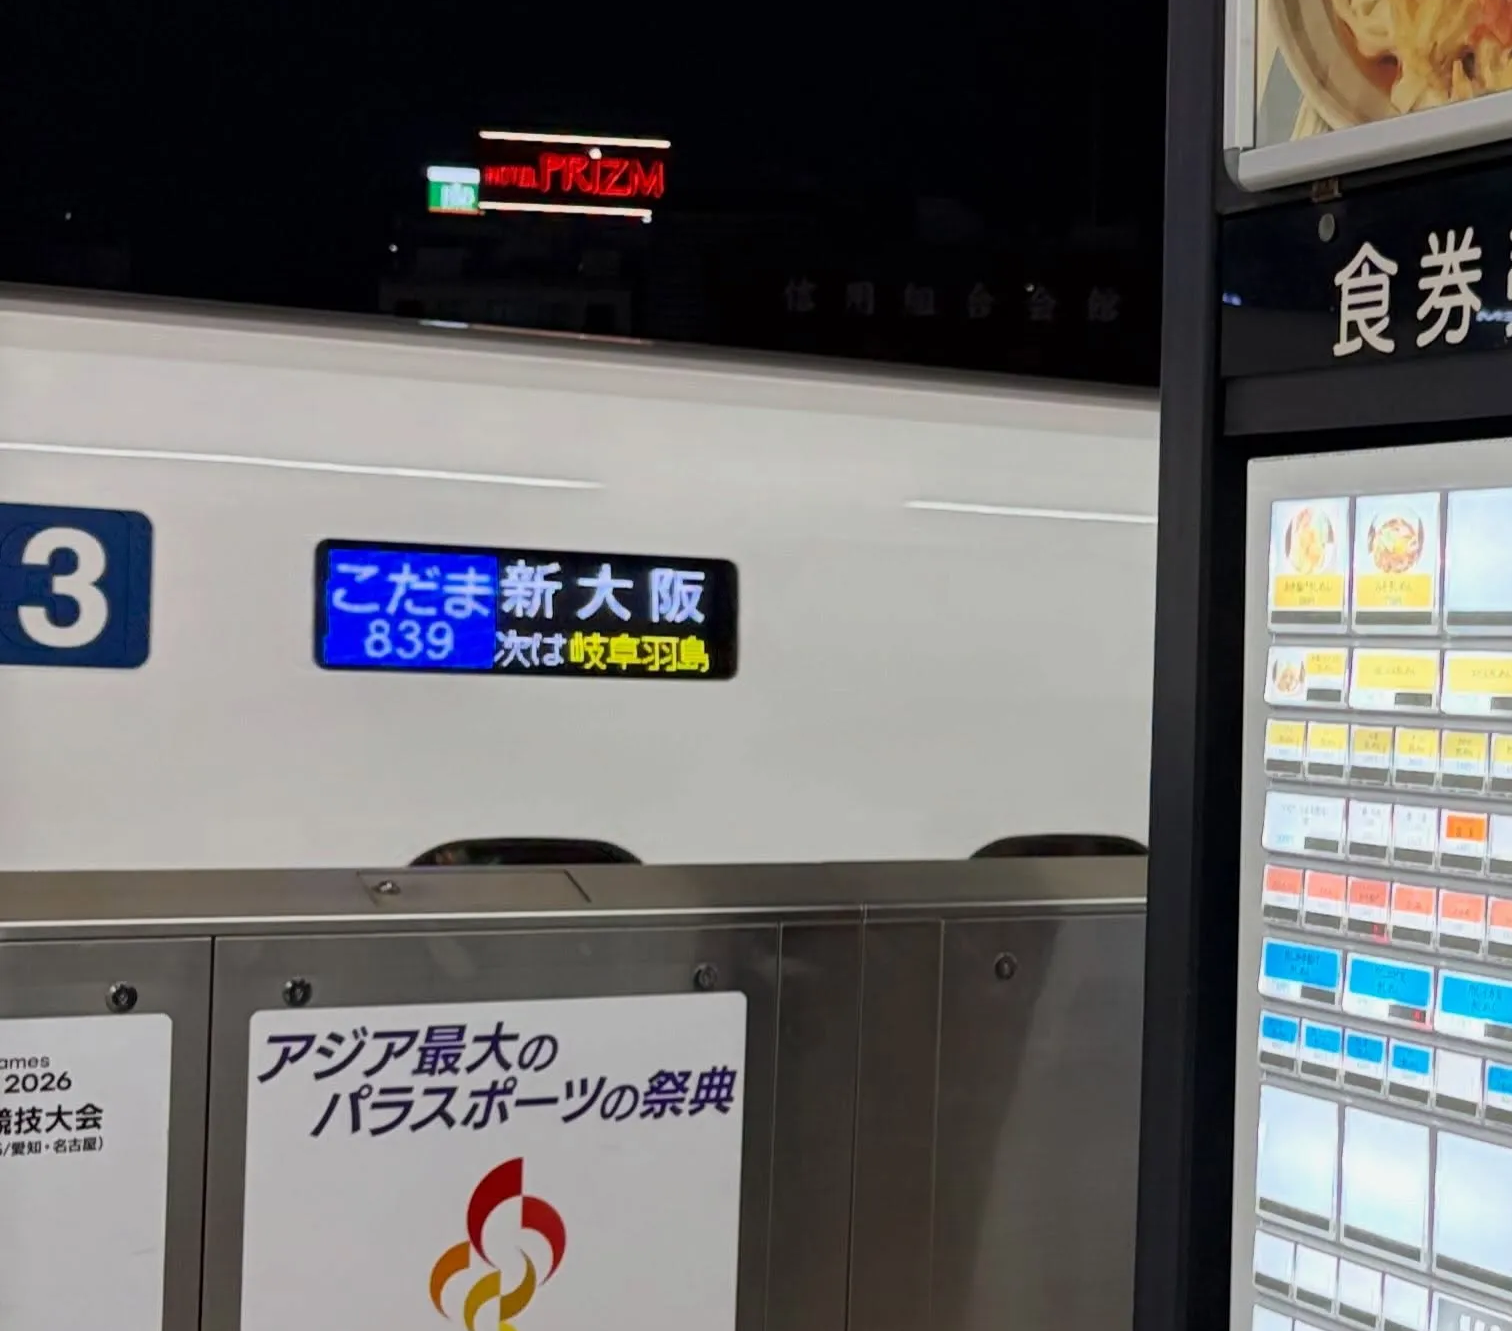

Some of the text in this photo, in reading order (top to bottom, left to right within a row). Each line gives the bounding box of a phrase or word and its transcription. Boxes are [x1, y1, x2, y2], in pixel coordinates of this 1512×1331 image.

[17, 526, 108, 649] 3
[331, 558, 706, 625] こだま 新大阪
[363, 620, 454, 662] 839
[4, 1071, 72, 1094] 2026
[258, 1021, 558, 1083] アジア最大の
[311, 1066, 737, 1138] パラスポーツの祭典
